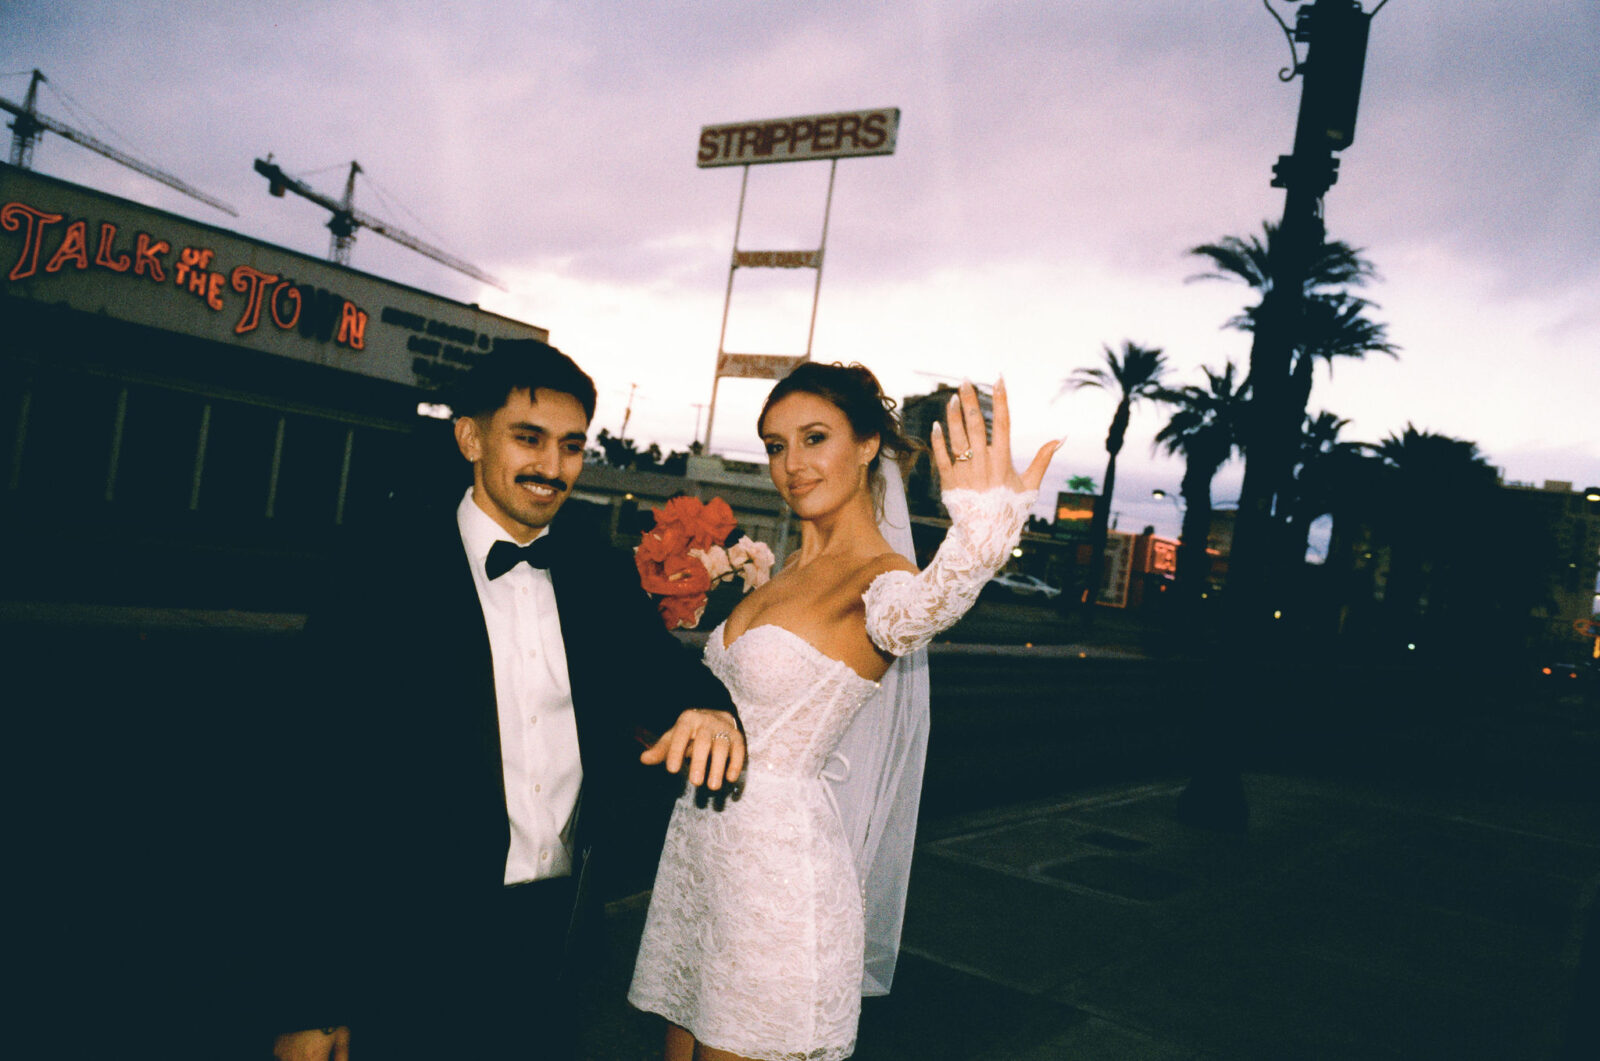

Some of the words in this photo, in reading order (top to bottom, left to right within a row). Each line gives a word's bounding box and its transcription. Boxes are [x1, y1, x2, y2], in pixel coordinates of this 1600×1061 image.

[697, 113, 888, 161] STRIPPERS
[1, 202, 170, 282] TALK
[181, 247, 215, 270] OF
[176, 262, 226, 311] THE
